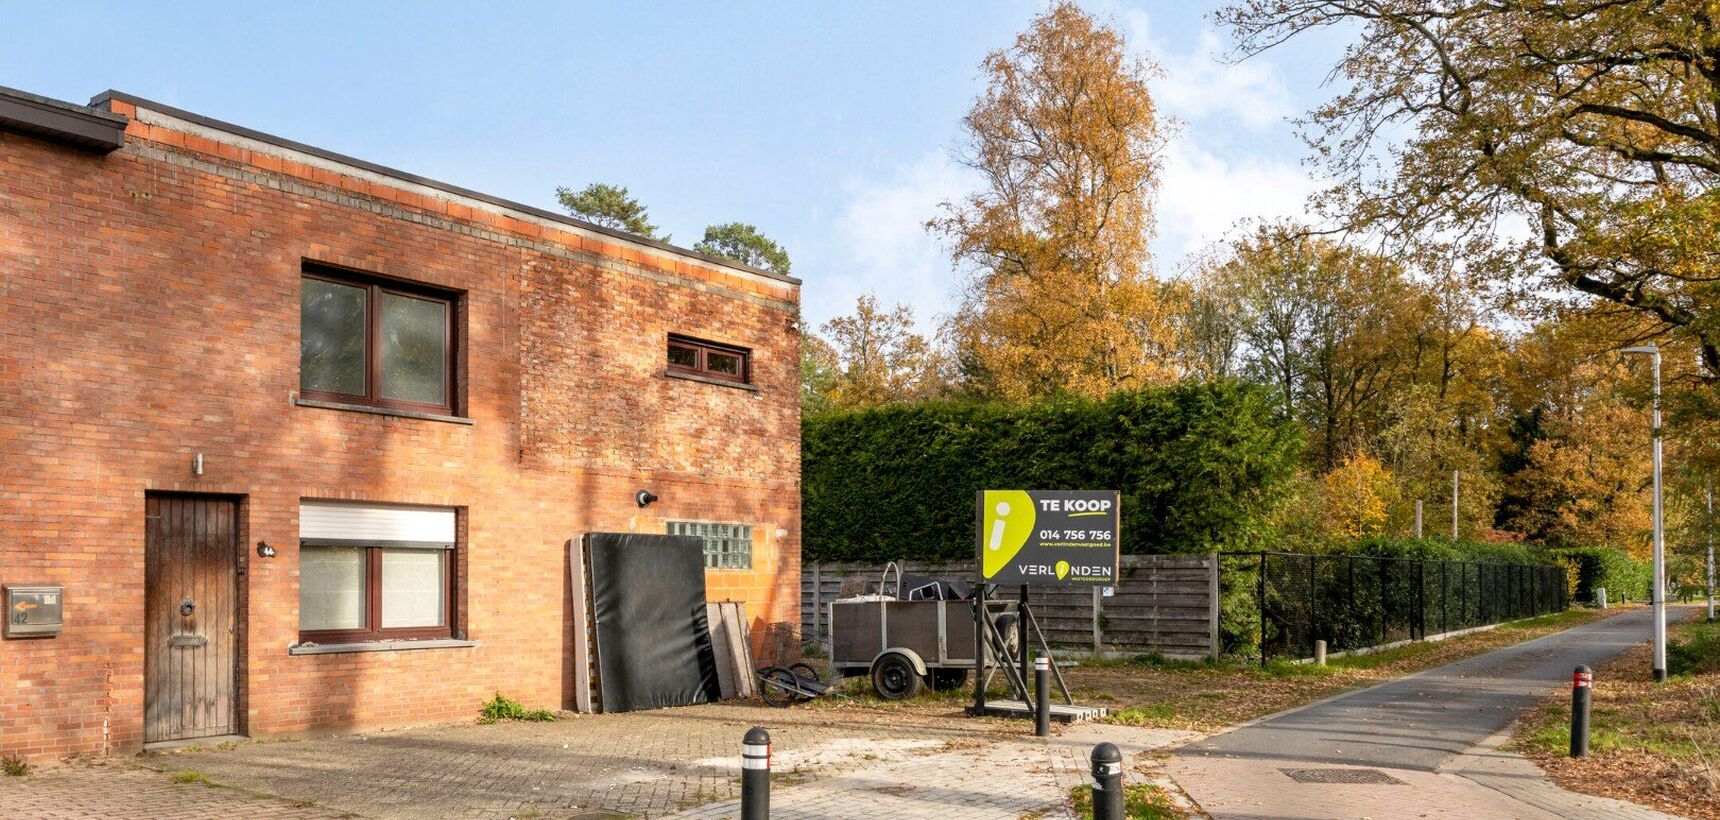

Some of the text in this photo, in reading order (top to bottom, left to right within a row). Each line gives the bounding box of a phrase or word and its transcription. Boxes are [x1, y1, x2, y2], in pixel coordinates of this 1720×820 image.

[1040, 499, 1112, 512] TE KOOP
[1040, 529, 1111, 540] 014 756 756
[15, 612, 28, 625] 42
